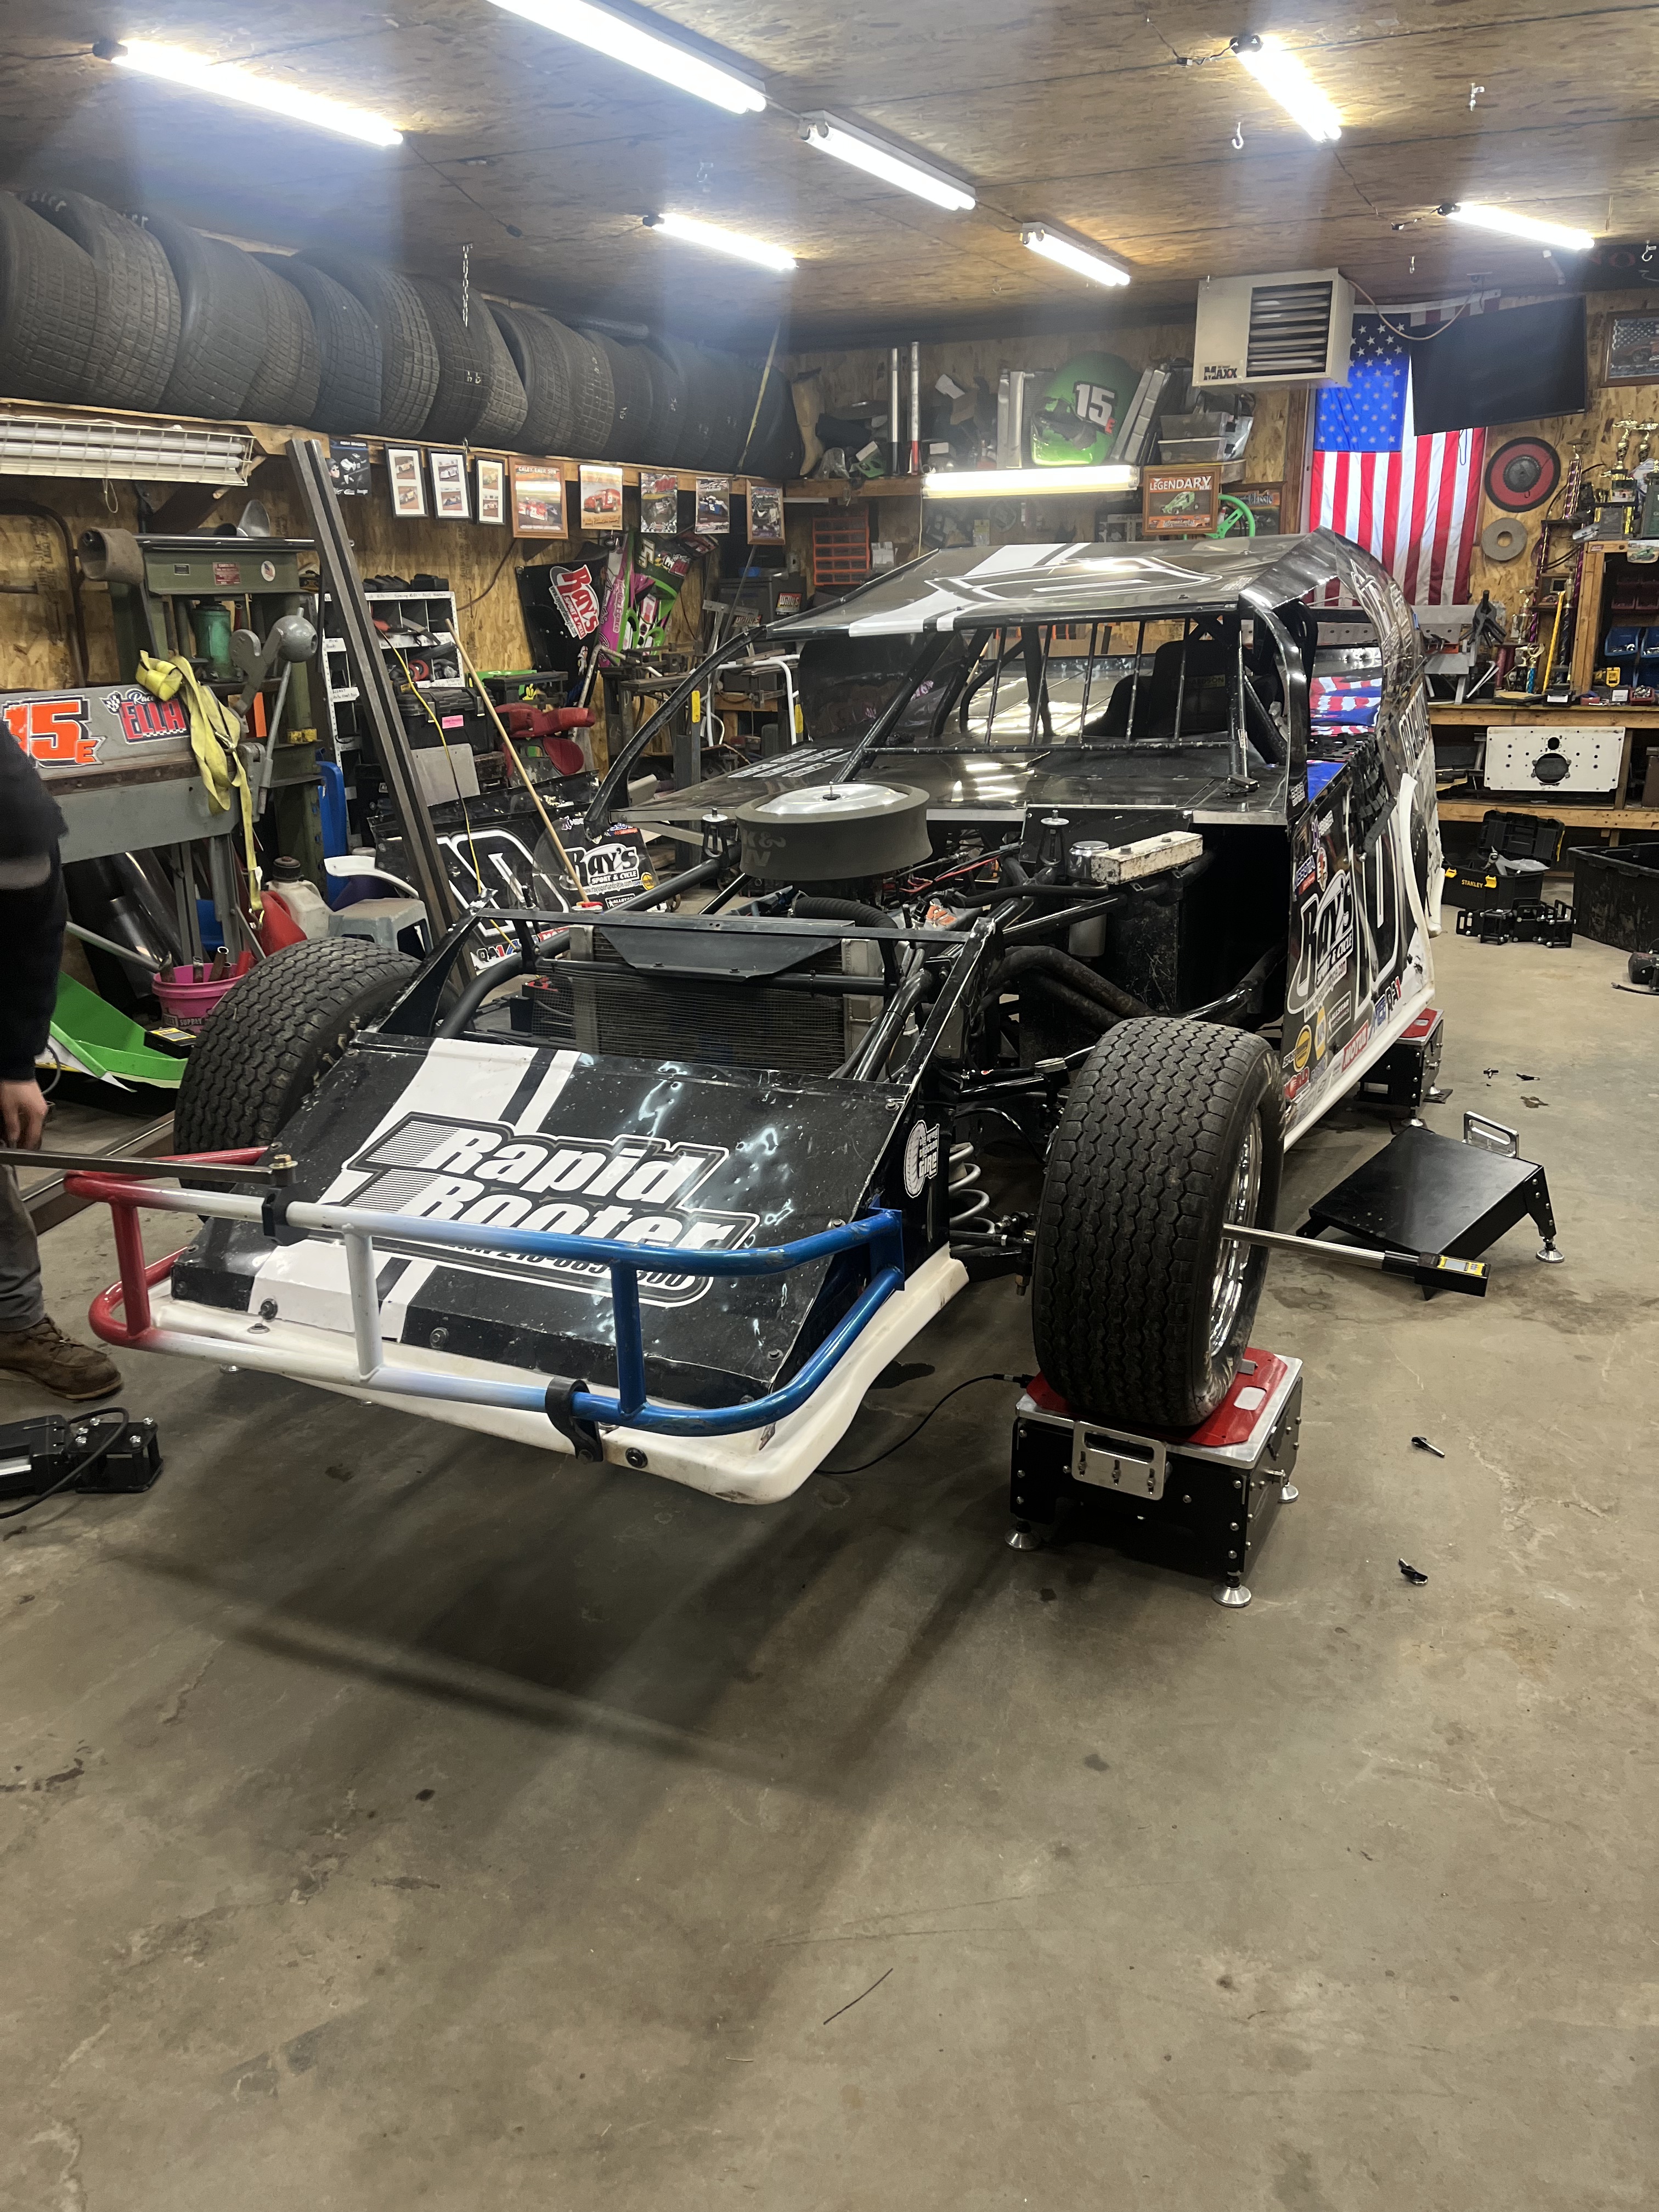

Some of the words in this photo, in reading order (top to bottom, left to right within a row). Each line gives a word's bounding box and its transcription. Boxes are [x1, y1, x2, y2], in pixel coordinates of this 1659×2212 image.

[1150, 476, 1212, 490] LEGENDARY
[121, 698, 187, 739] ELLA
[591, 876, 612, 884] SPORT
[619, 871, 637, 879] CYCLE
[1461, 879, 1483, 888] STANLEY
[418, 1127, 708, 1204] Rapid
